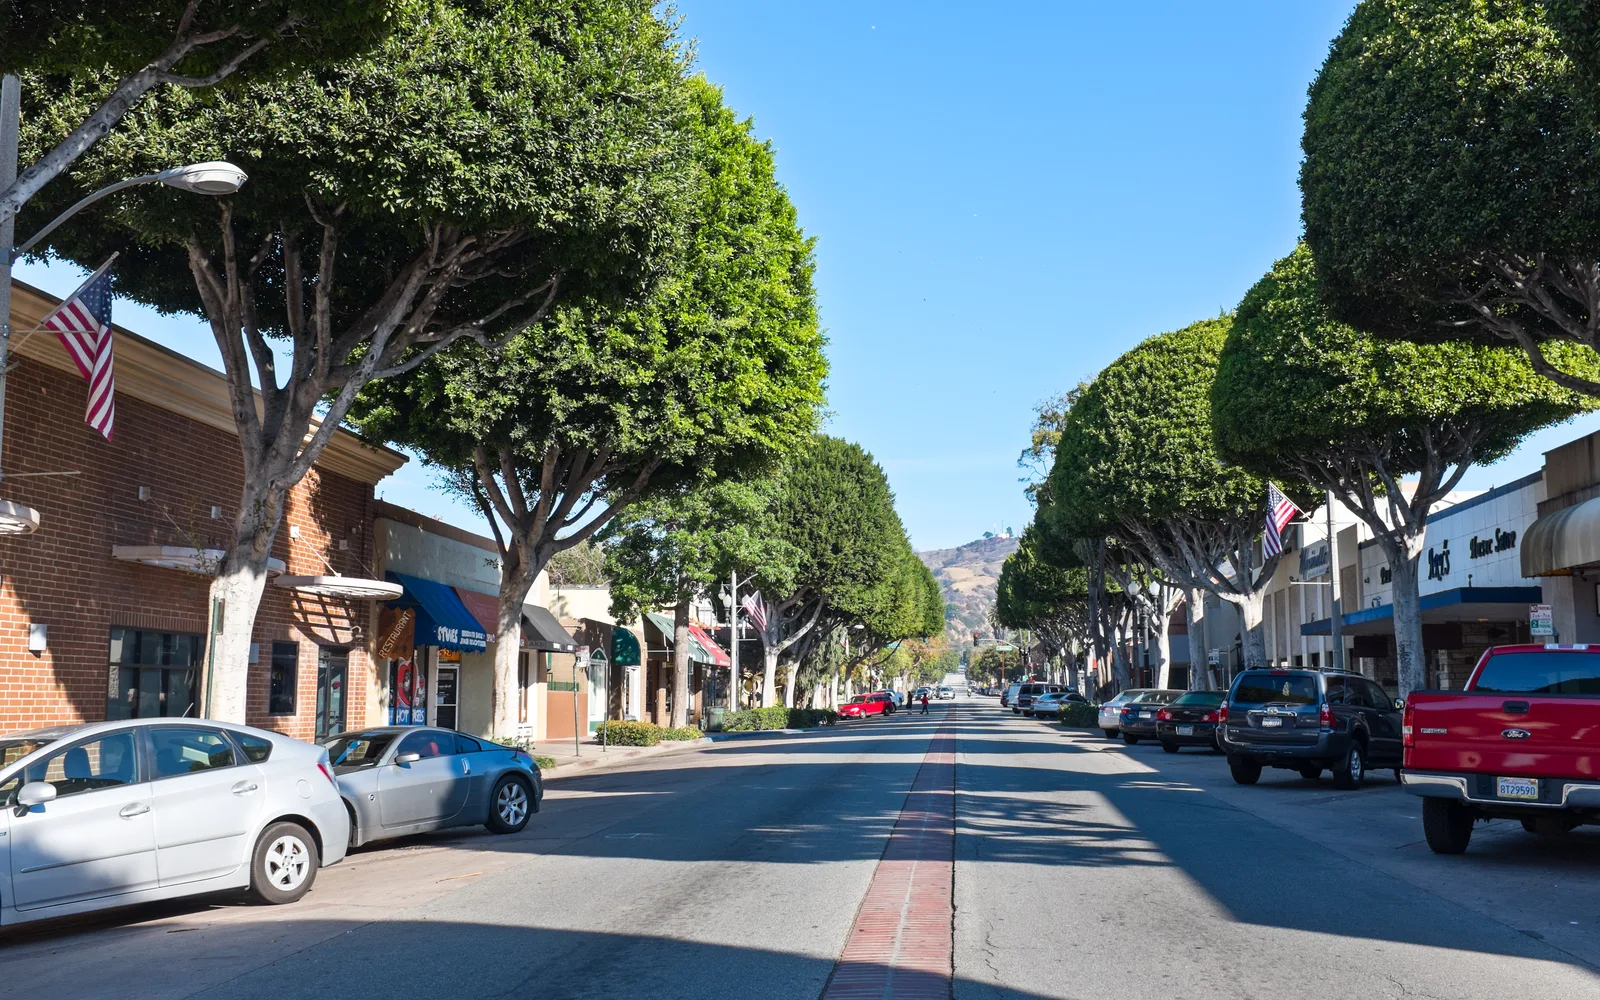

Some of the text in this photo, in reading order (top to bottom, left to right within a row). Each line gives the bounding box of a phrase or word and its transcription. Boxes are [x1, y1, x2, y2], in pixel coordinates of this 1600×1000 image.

[1470, 528, 1516, 559] Music Store
[1532, 620, 1538, 628] 2
[378, 610, 412, 659] RESTAURANT
[396, 709, 409, 724] HOT
[1500, 785, 1536, 796] 8T29590
